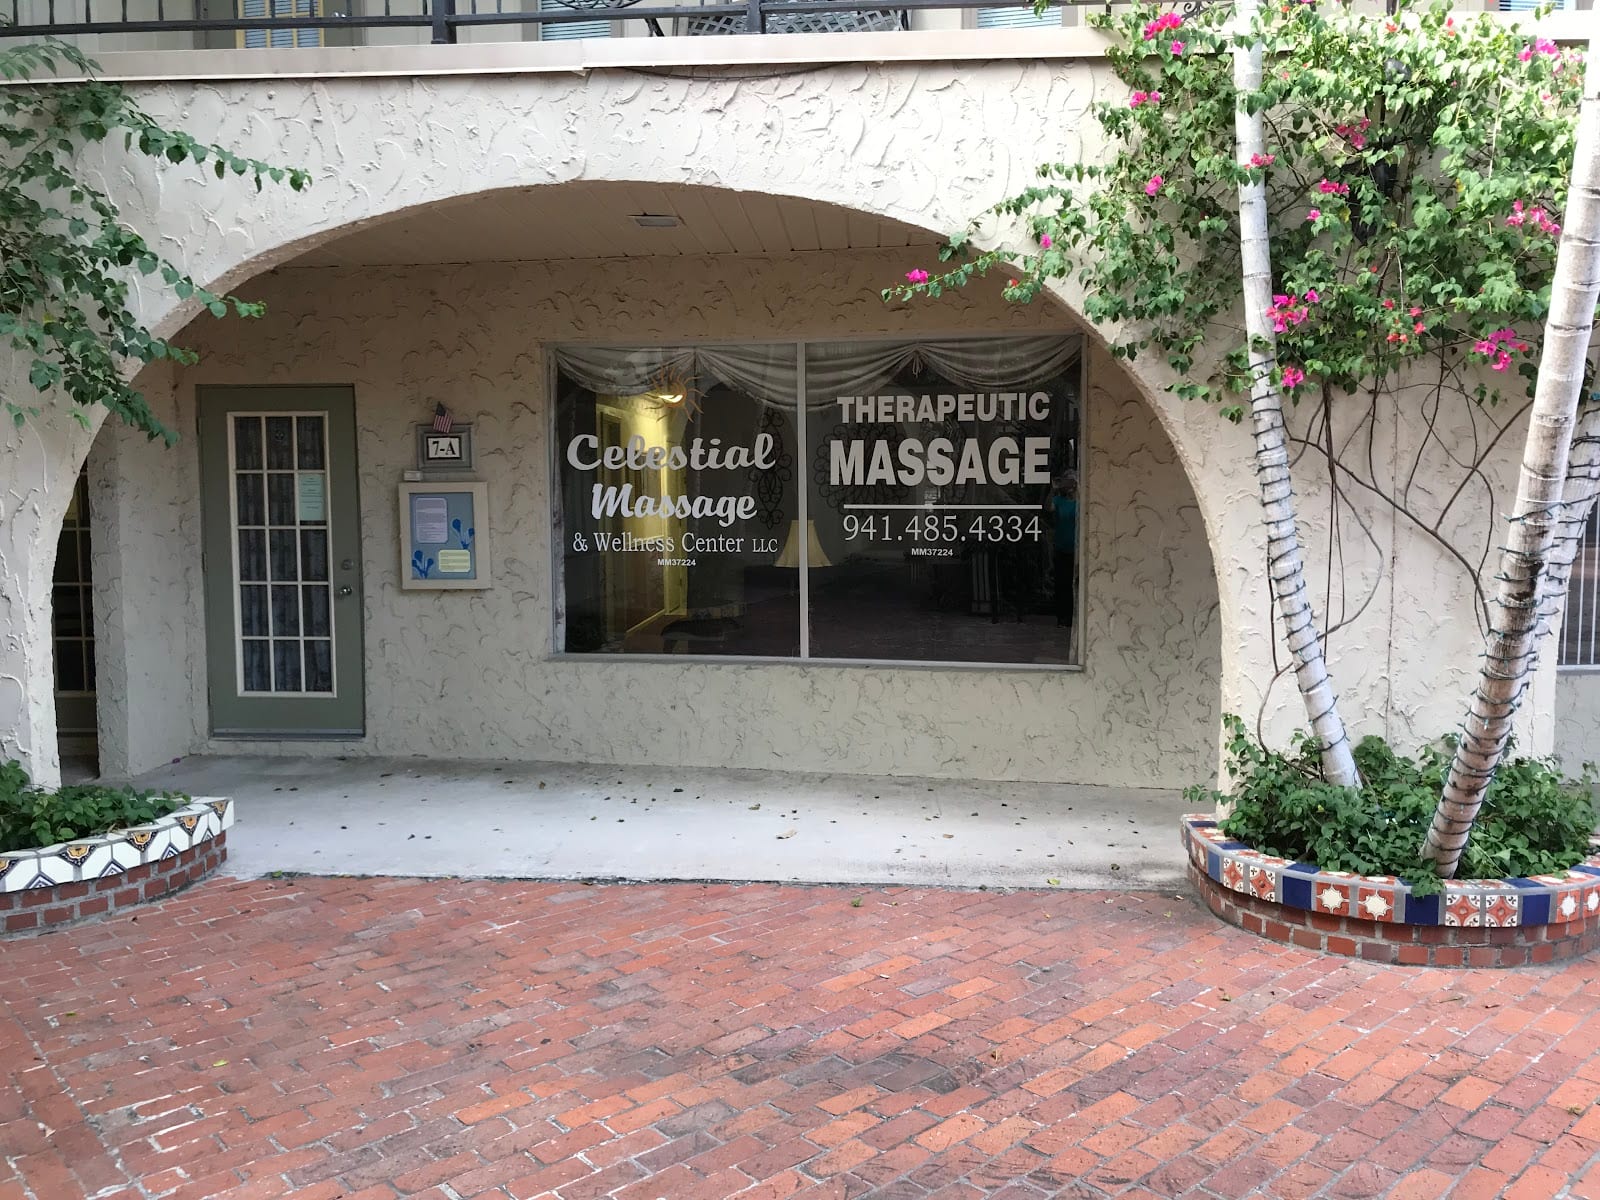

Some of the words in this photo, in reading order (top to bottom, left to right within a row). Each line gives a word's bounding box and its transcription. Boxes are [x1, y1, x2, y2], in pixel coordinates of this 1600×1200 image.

[837, 391, 1050, 423] THERAPEUTIC
[432, 440, 456, 456] 7-A
[567, 433, 776, 471] Celestial
[830, 436, 1051, 487] MASSAGE
[591, 483, 757, 528] Massage
[572, 532, 588, 552] &
[593, 531, 675, 553] Wellness
[681, 532, 744, 553] Center
[752, 538, 778, 553] LLC
[843, 514, 1042, 542] 941.485.4334
[657, 558, 696, 567] MM37224
[911, 548, 953, 556] MM37224
